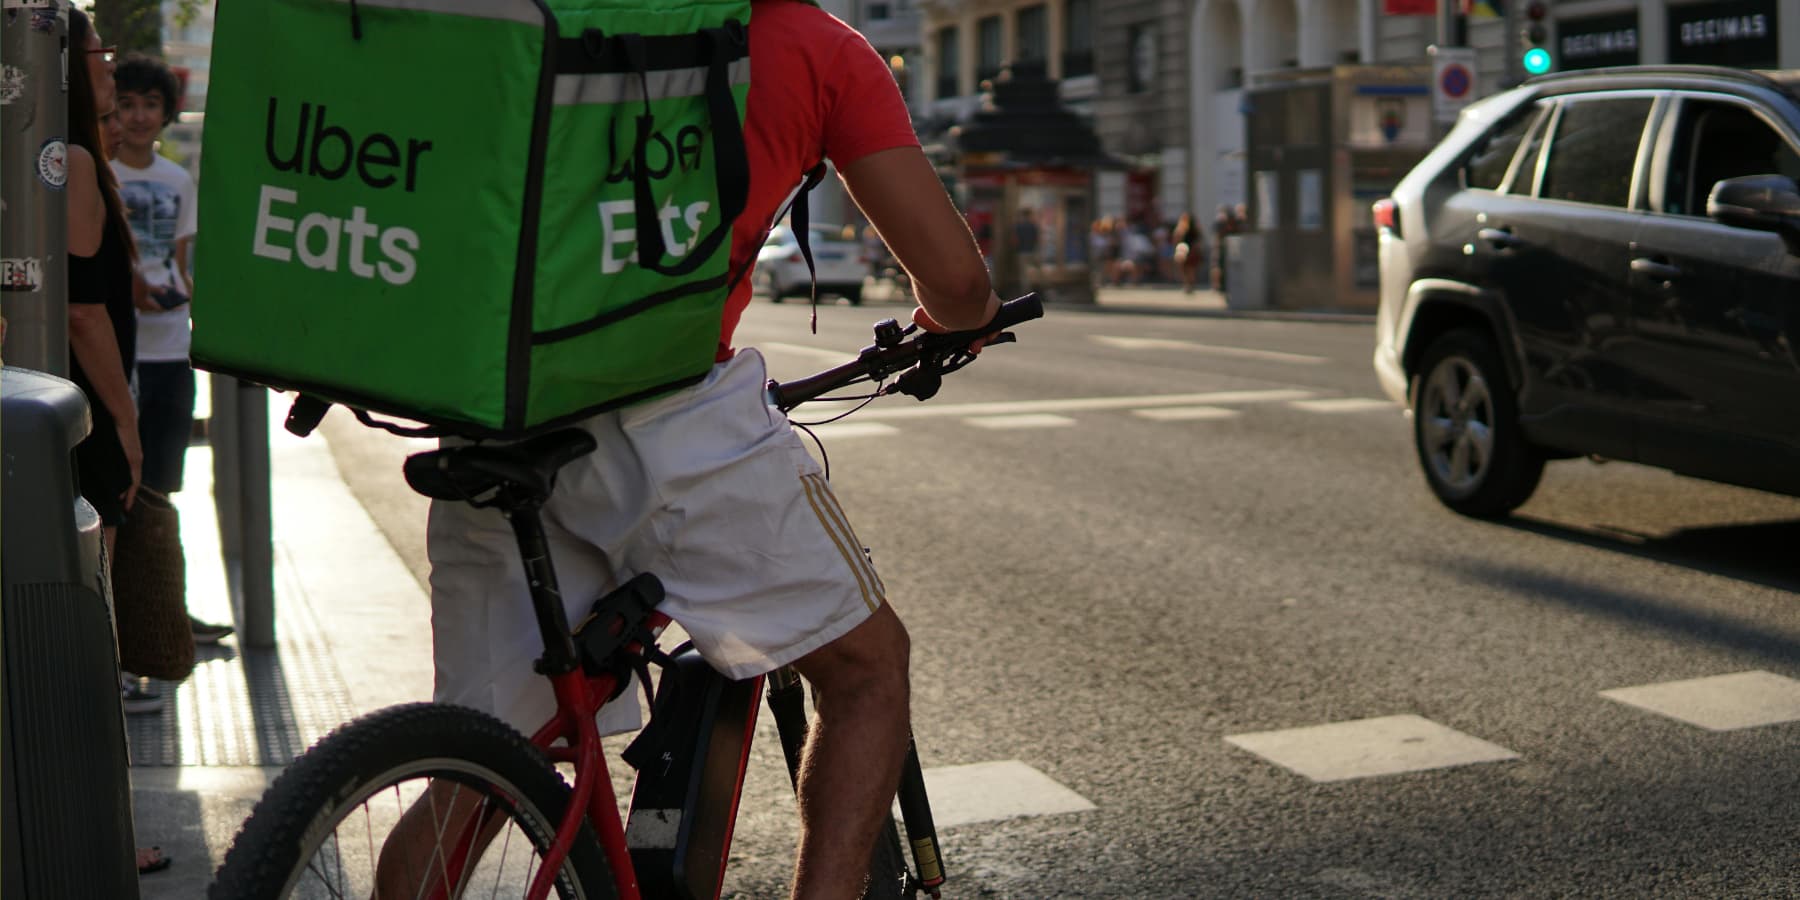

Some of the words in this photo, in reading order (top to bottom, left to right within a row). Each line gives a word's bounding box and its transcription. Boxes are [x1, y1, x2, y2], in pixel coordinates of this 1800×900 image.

[1681, 13, 1766, 44] DECIMAS
[264, 96, 433, 193] Uber
[253, 185, 419, 285] Eats
[598, 194, 711, 275] Ets
